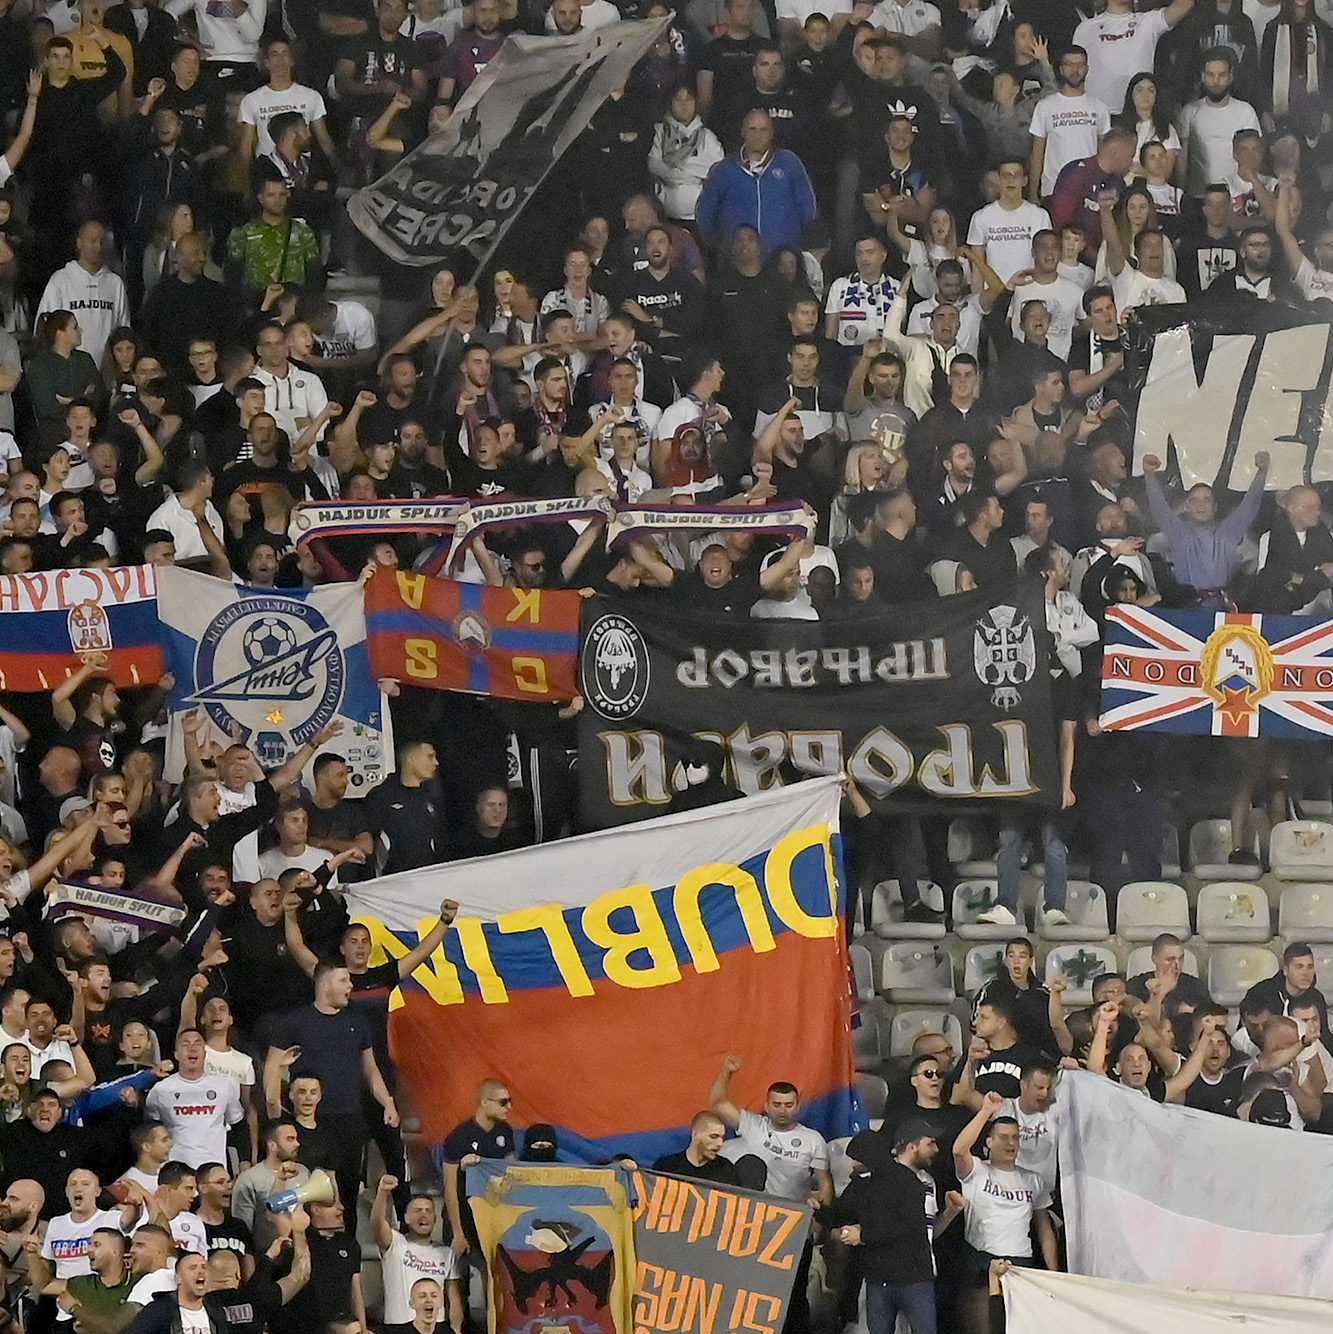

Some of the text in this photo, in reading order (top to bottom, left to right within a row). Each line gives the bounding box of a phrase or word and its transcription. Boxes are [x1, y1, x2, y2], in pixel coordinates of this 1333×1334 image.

[69, 299, 114, 311] HAJDUK
[319, 505, 454, 523] HAJDUK SPLIT
[472, 497, 591, 524] HAJDUK SPLIT
[644, 512, 768, 525] HAJDUK SPLIT
[76, 889, 166, 918] HAJDUK SPLIT
[369, 822, 838, 1010] DUBLIN
